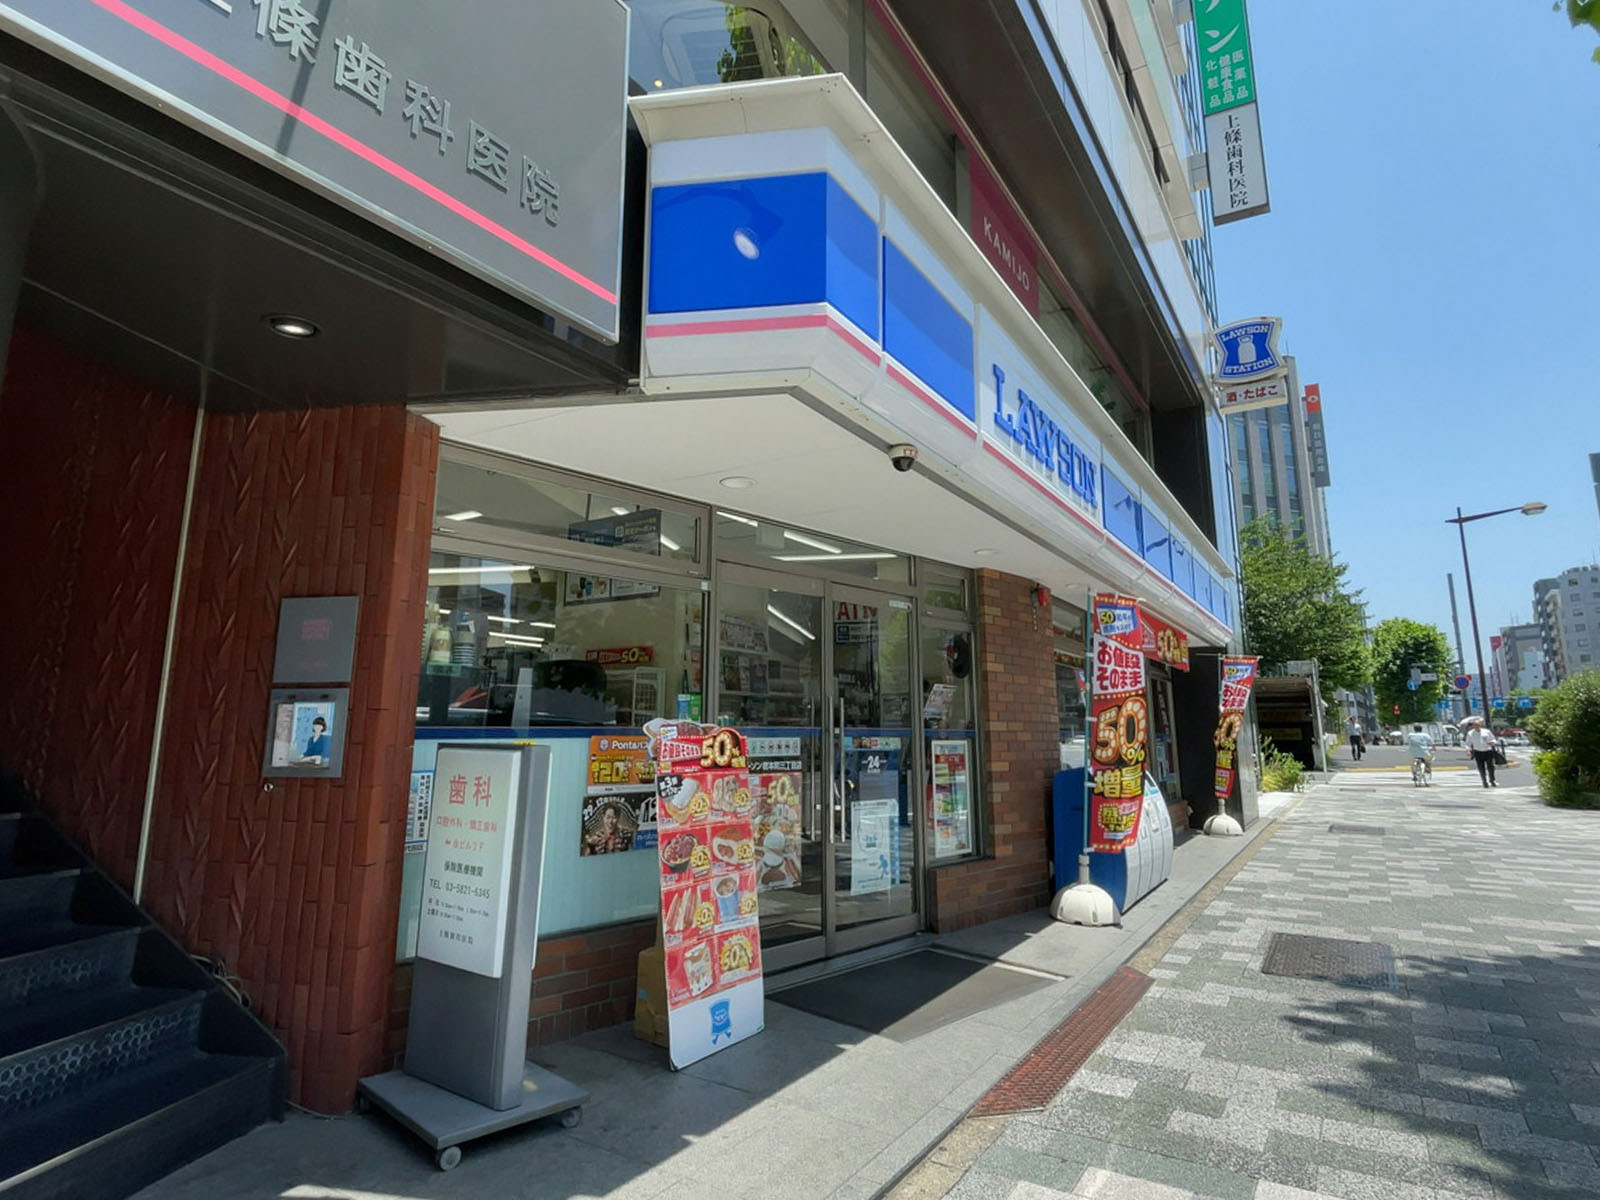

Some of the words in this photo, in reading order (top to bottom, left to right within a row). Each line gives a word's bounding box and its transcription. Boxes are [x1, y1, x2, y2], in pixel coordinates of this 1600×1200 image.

[187, 0, 561, 226] 條歯科医院
[983, 217, 1030, 292] KAMIJO
[1221, 324, 1270, 342] LAWSON
[1224, 357, 1273, 374] STATION
[992, 363, 1098, 508] LAWSON
[1097, 641, 1141, 669] お値段
[1096, 667, 1142, 690] そのまま
[449, 774, 492, 807] 歯科
[1093, 763, 1143, 798] 増量
[429, 878, 441, 890] TEL
